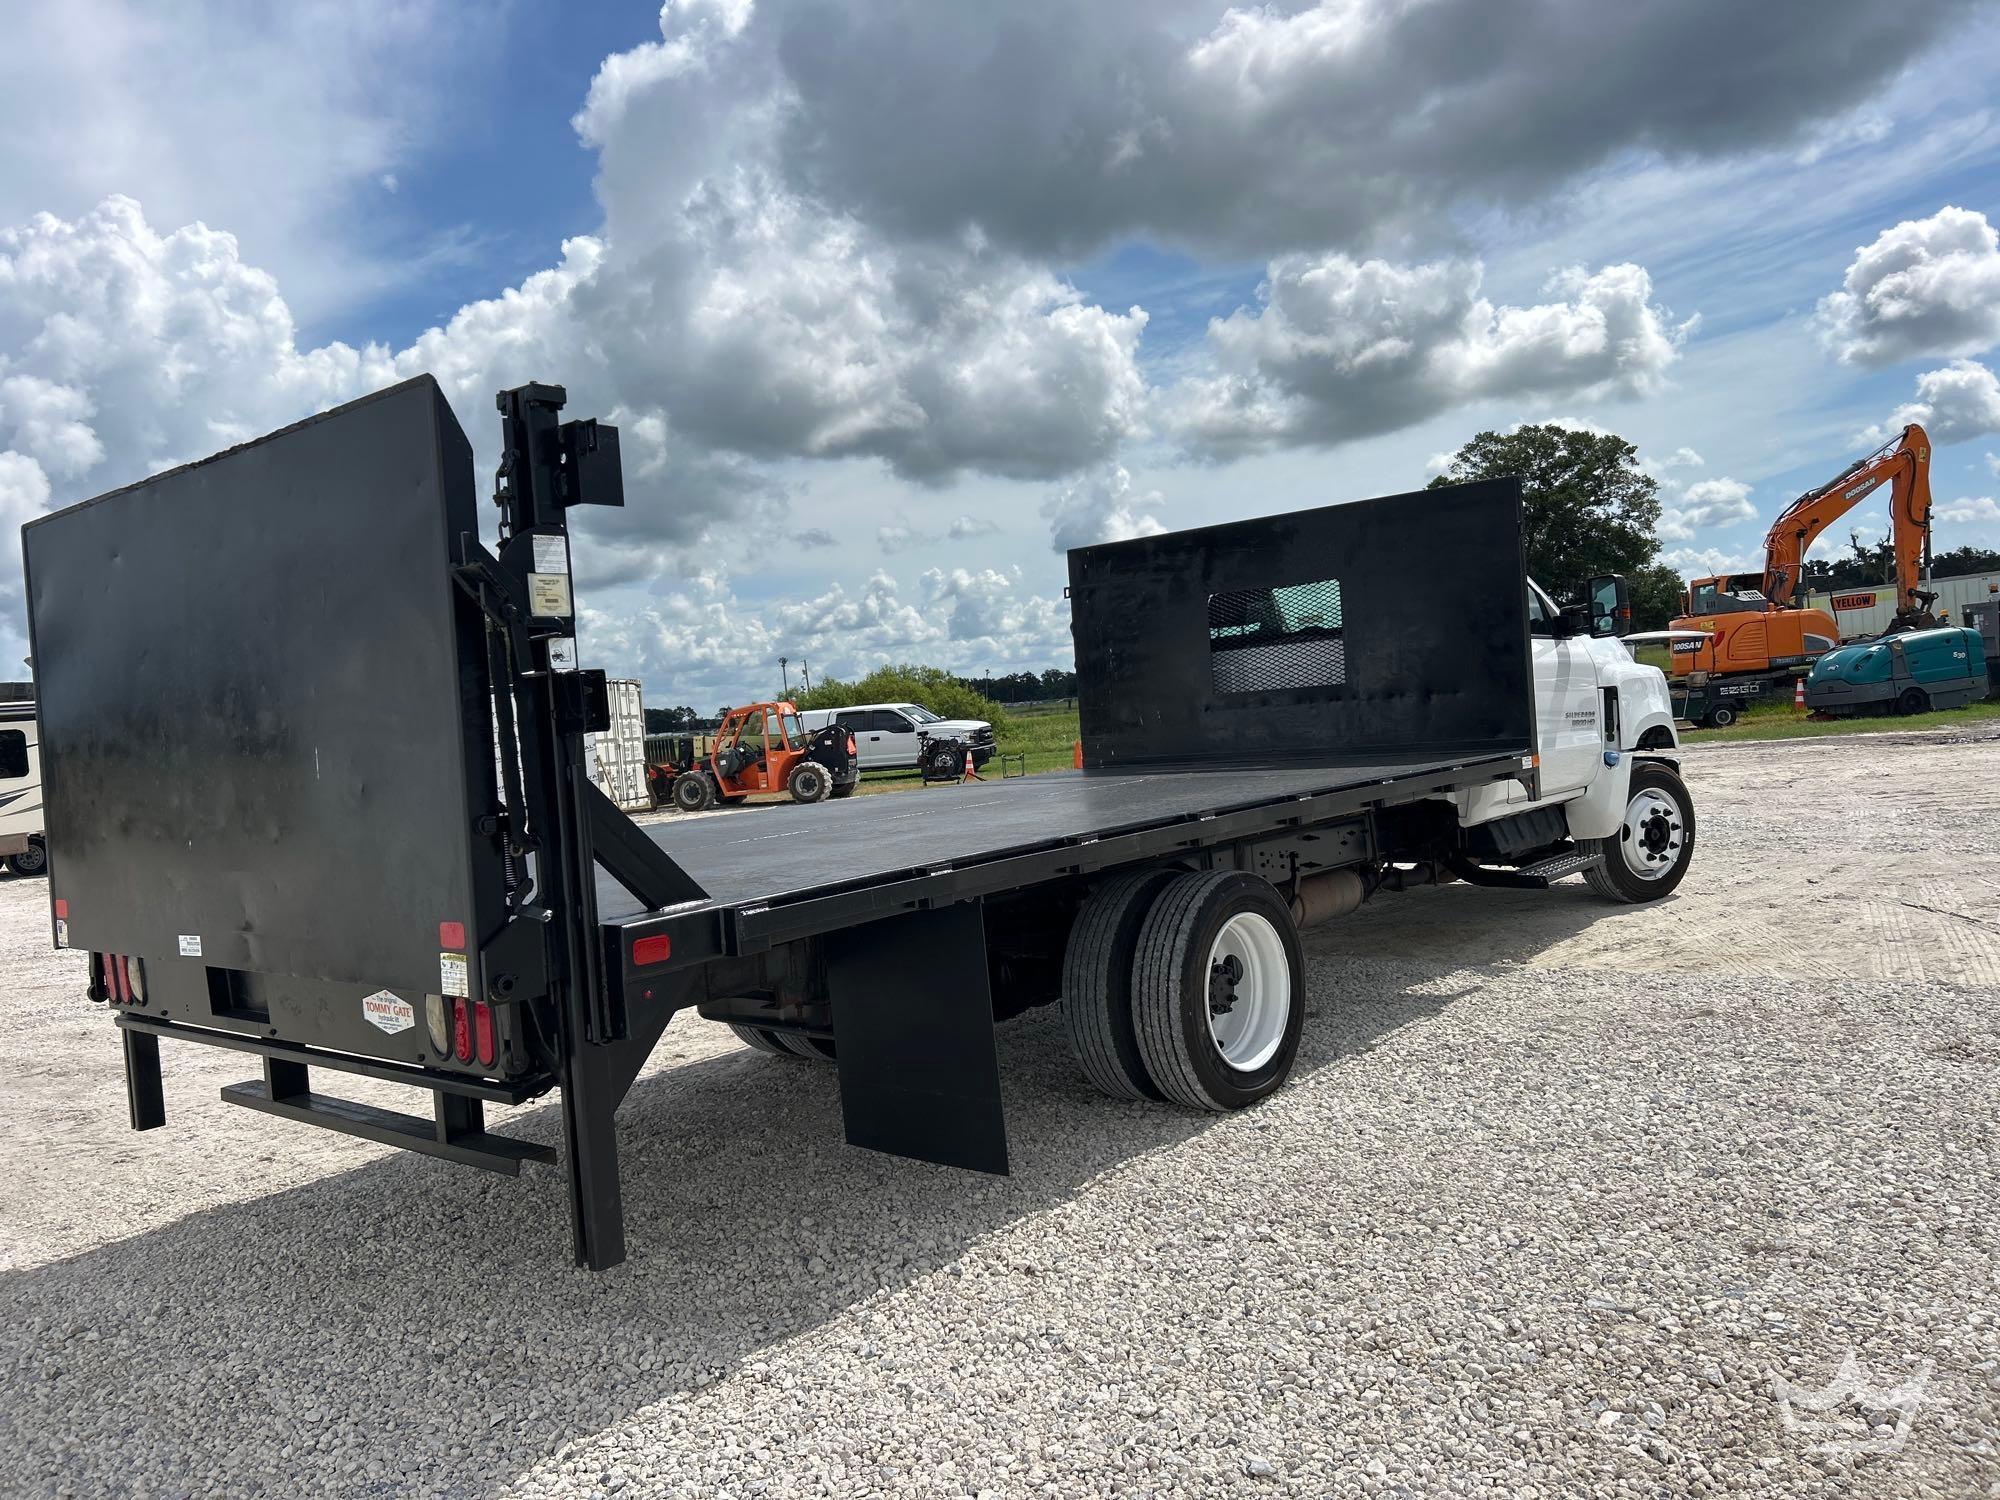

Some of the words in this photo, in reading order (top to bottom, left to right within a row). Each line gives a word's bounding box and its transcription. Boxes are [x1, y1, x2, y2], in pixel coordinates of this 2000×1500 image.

[1845, 477, 1876, 499] DOOSAN
[1836, 594, 1871, 608] YELLOW
[1952, 651, 1966, 659] S30
[365, 1002, 391, 1014] TOMMY
[393, 1005, 412, 1017] GATE
